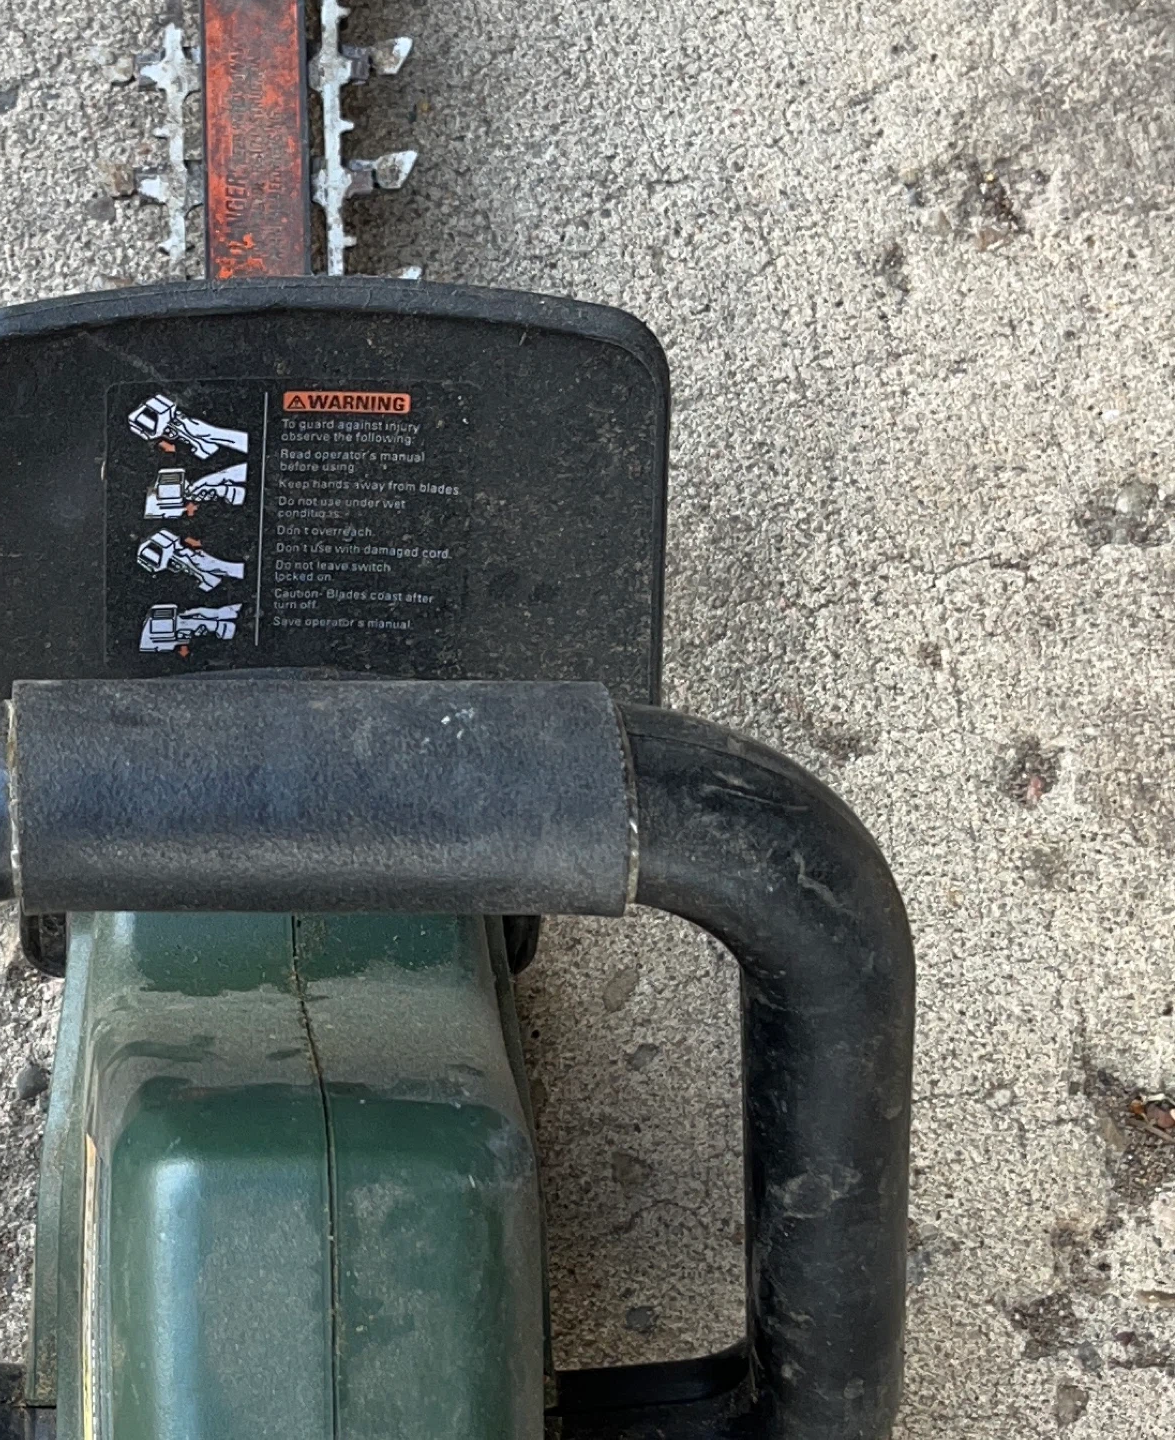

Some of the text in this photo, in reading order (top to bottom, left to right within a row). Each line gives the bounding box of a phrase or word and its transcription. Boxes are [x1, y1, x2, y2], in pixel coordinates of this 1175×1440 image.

[309, 395, 406, 411] WARNING
[281, 419, 420, 434] To guard against injury
[281, 433, 330, 441] observe
[333, 433, 352, 442] the
[280, 449, 310, 459] Read
[380, 452, 425, 462] manual
[280, 461, 319, 472] before
[278, 480, 310, 490] Keep
[312, 480, 350, 489] hands
[388, 480, 415, 491] from
[278, 496, 406, 509] Do not use under wet
[335, 543, 361, 554] with
[363, 545, 418, 558] damaged
[275, 560, 391, 572] Do not leave switch
[275, 572, 313, 583] locked
[327, 589, 366, 600] Blades
[370, 591, 402, 601] coast
[406, 592, 434, 604] after
[274, 600, 296, 609] turn
[273, 616, 301, 627] Save
